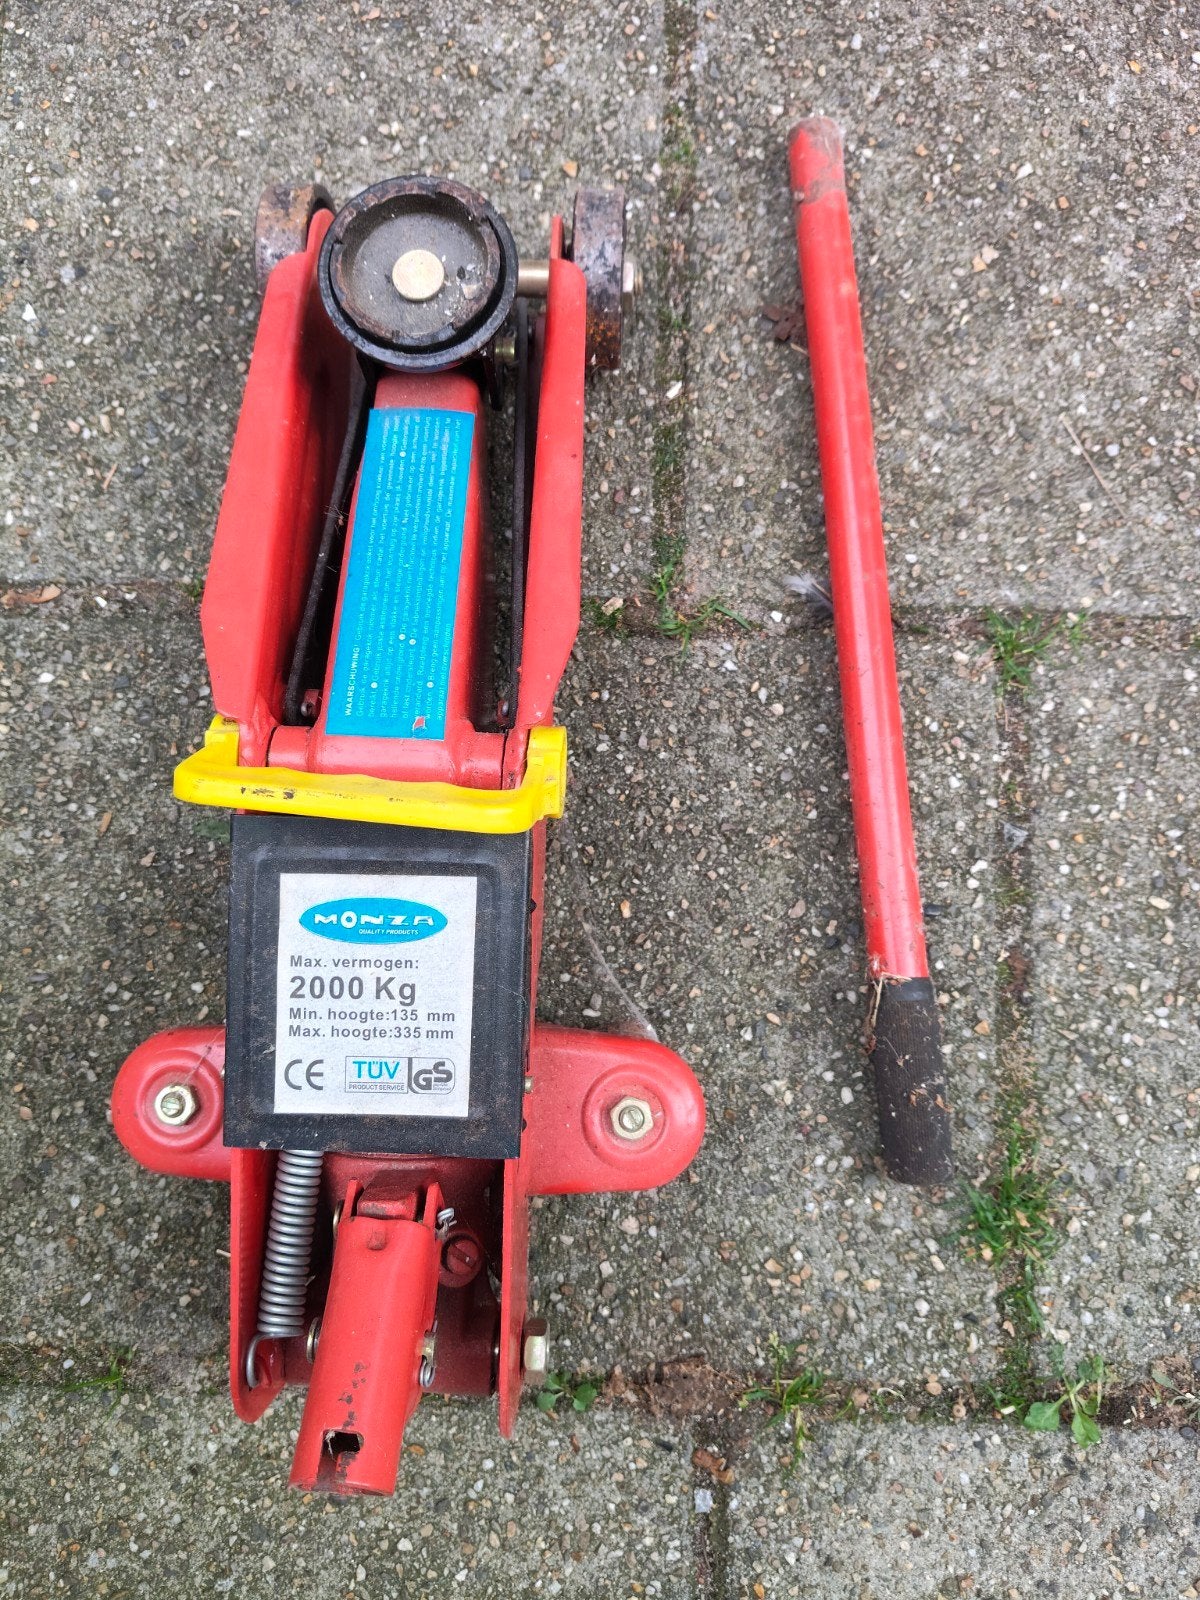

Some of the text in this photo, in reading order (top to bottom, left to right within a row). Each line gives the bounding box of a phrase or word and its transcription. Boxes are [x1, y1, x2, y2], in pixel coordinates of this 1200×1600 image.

[314, 910, 434, 928] MONZA
[290, 955, 419, 971] Max. vermogen:
[289, 975, 416, 1006] 2000 Kg
[289, 1007, 455, 1024] Min. hoogte:135 mm
[288, 1025, 454, 1041] Max. hoogte:335 mm
[352, 1060, 400, 1080] TÜV
